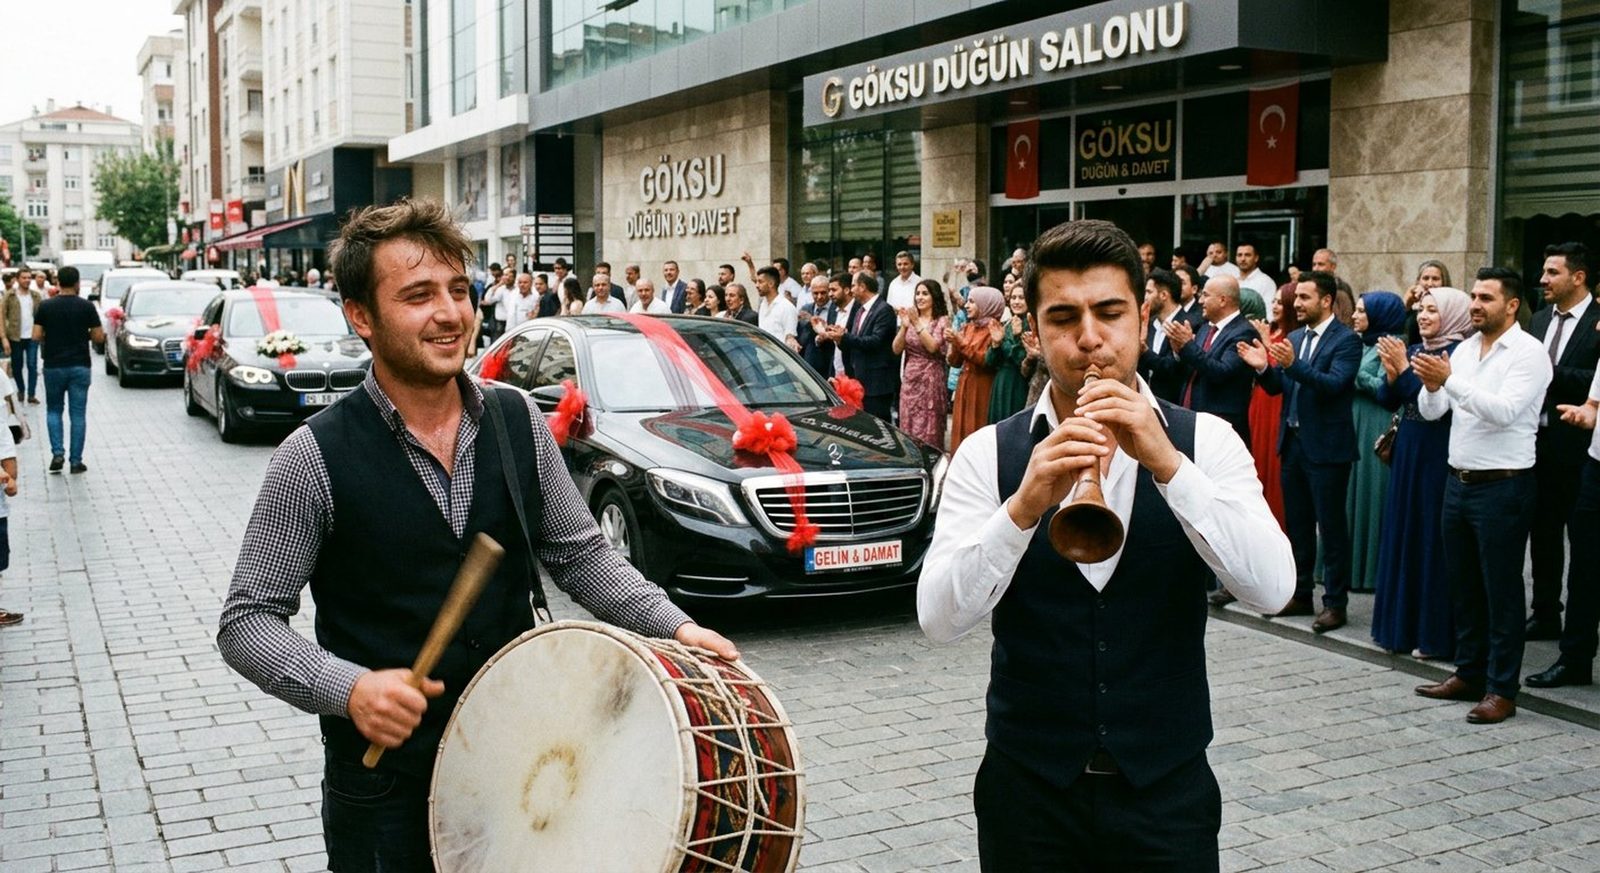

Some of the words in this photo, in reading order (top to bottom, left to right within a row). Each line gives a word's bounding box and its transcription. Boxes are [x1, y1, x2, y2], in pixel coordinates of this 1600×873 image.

[848, 62, 926, 111] GÖKSU
[933, 34, 1030, 94] DÜĞÜN
[1039, 1, 1185, 72] SALONU
[1079, 119, 1172, 160] GÖKSU
[639, 154, 725, 204] GÖKSU
[1121, 163, 1129, 177] &
[1132, 159, 1170, 176] DAVET
[626, 208, 672, 239] DÜĞÜN
[675, 212, 686, 236] &
[689, 206, 739, 235] DAVET
[852, 549, 860, 563] &
[863, 544, 900, 562] DAMAT
